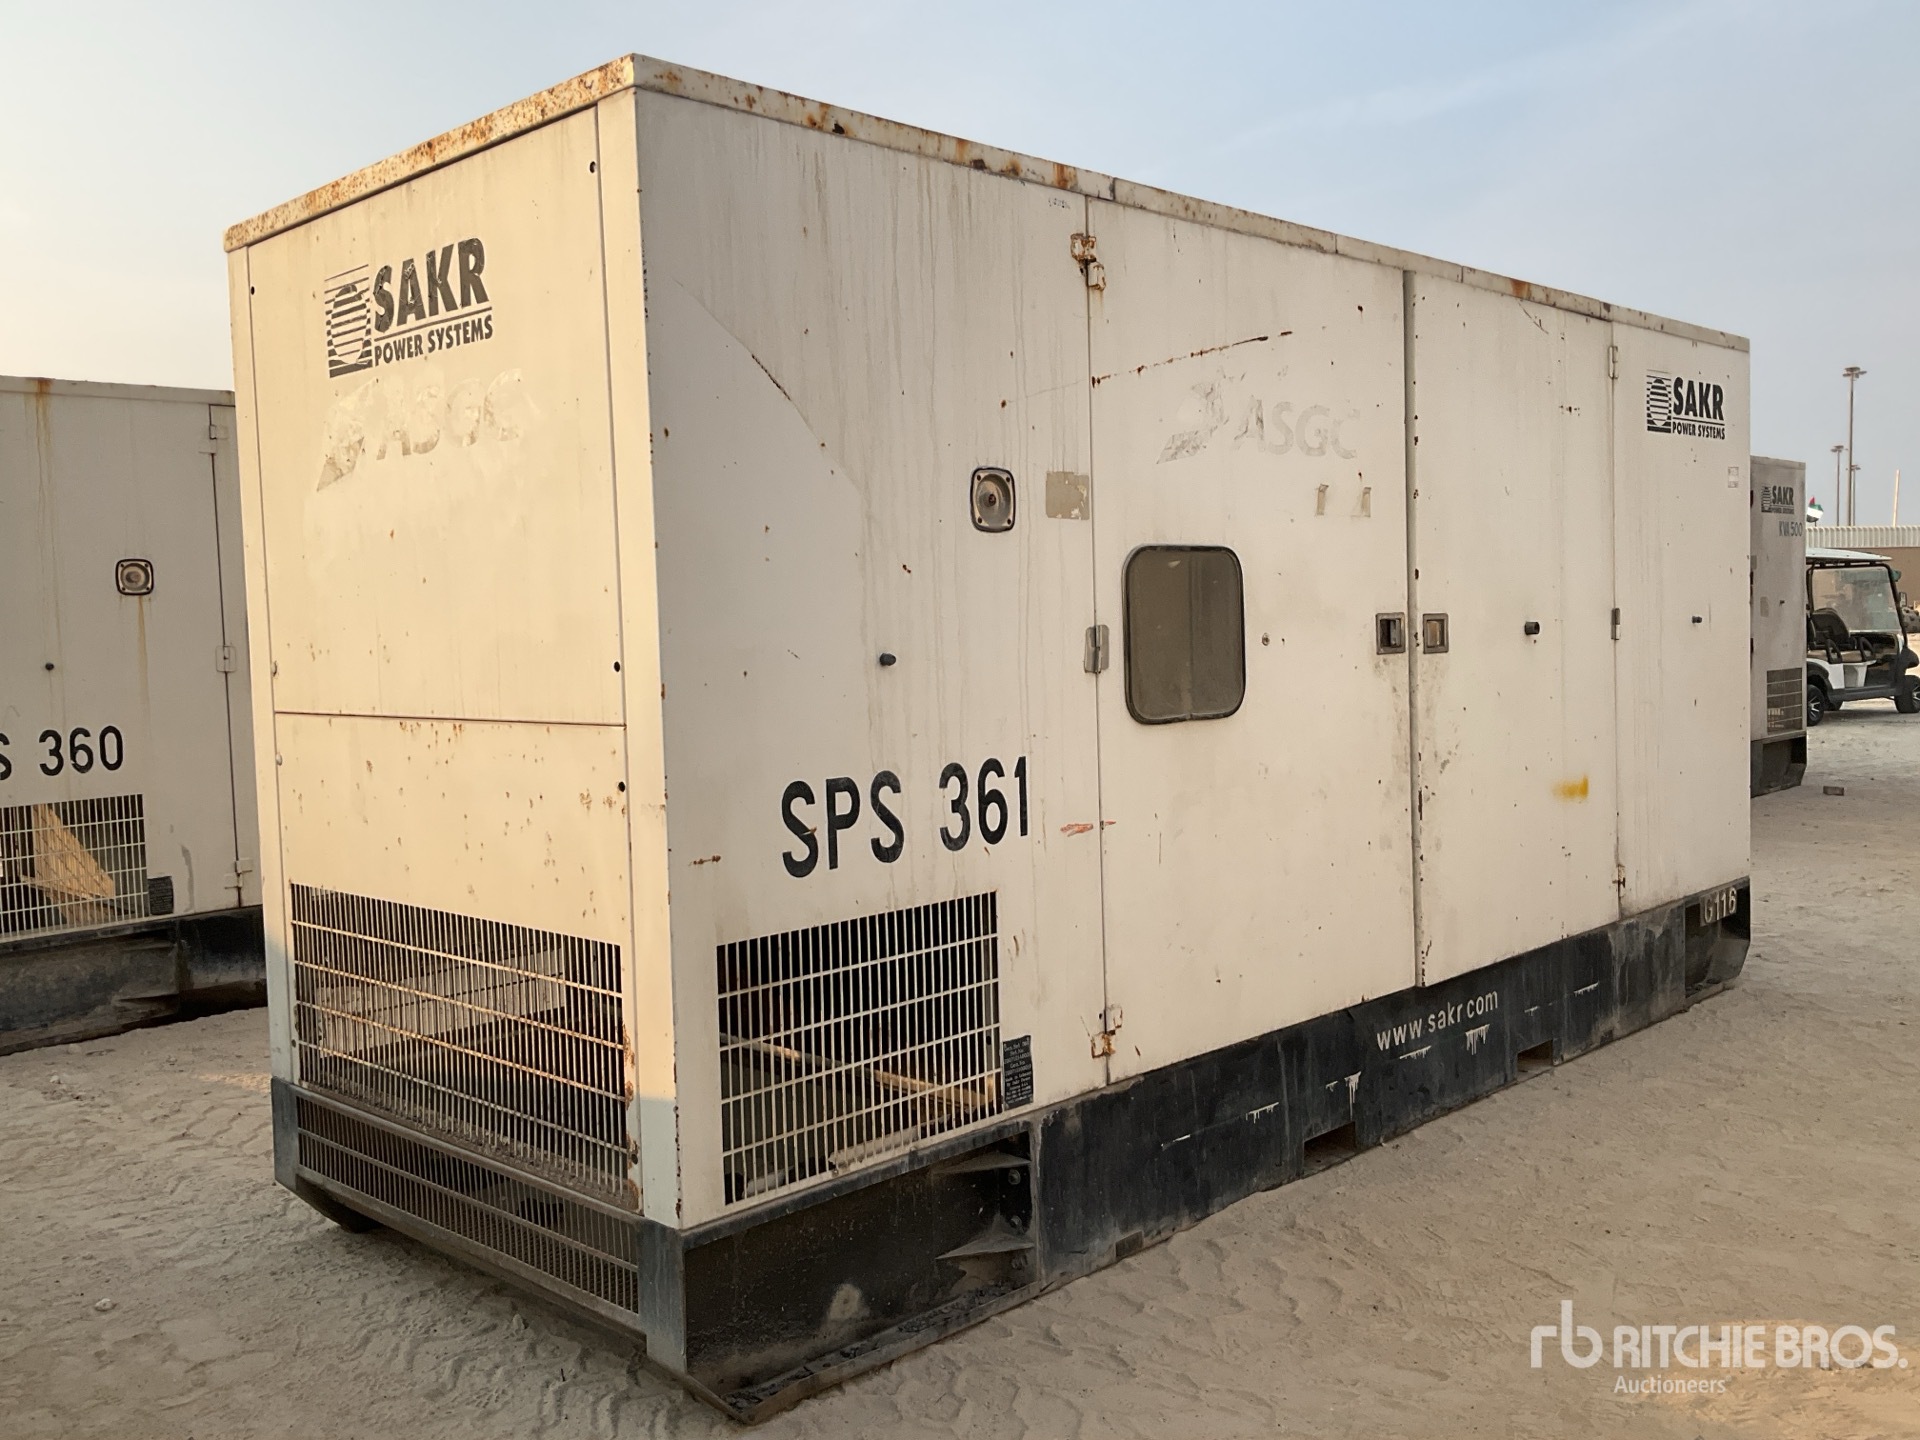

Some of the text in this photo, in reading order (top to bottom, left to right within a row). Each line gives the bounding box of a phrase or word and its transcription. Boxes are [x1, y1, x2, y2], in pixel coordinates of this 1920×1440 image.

[373, 238, 489, 333] SAKR
[374, 314, 493, 367] POWER SYSTEMS
[1673, 376, 1724, 421] SAKR
[1672, 421, 1725, 440] POWER SYSTEMS
[1772, 485, 1794, 505] SAKR
[39, 725, 124, 776] 360
[782, 756, 1028, 878] SPS 361
